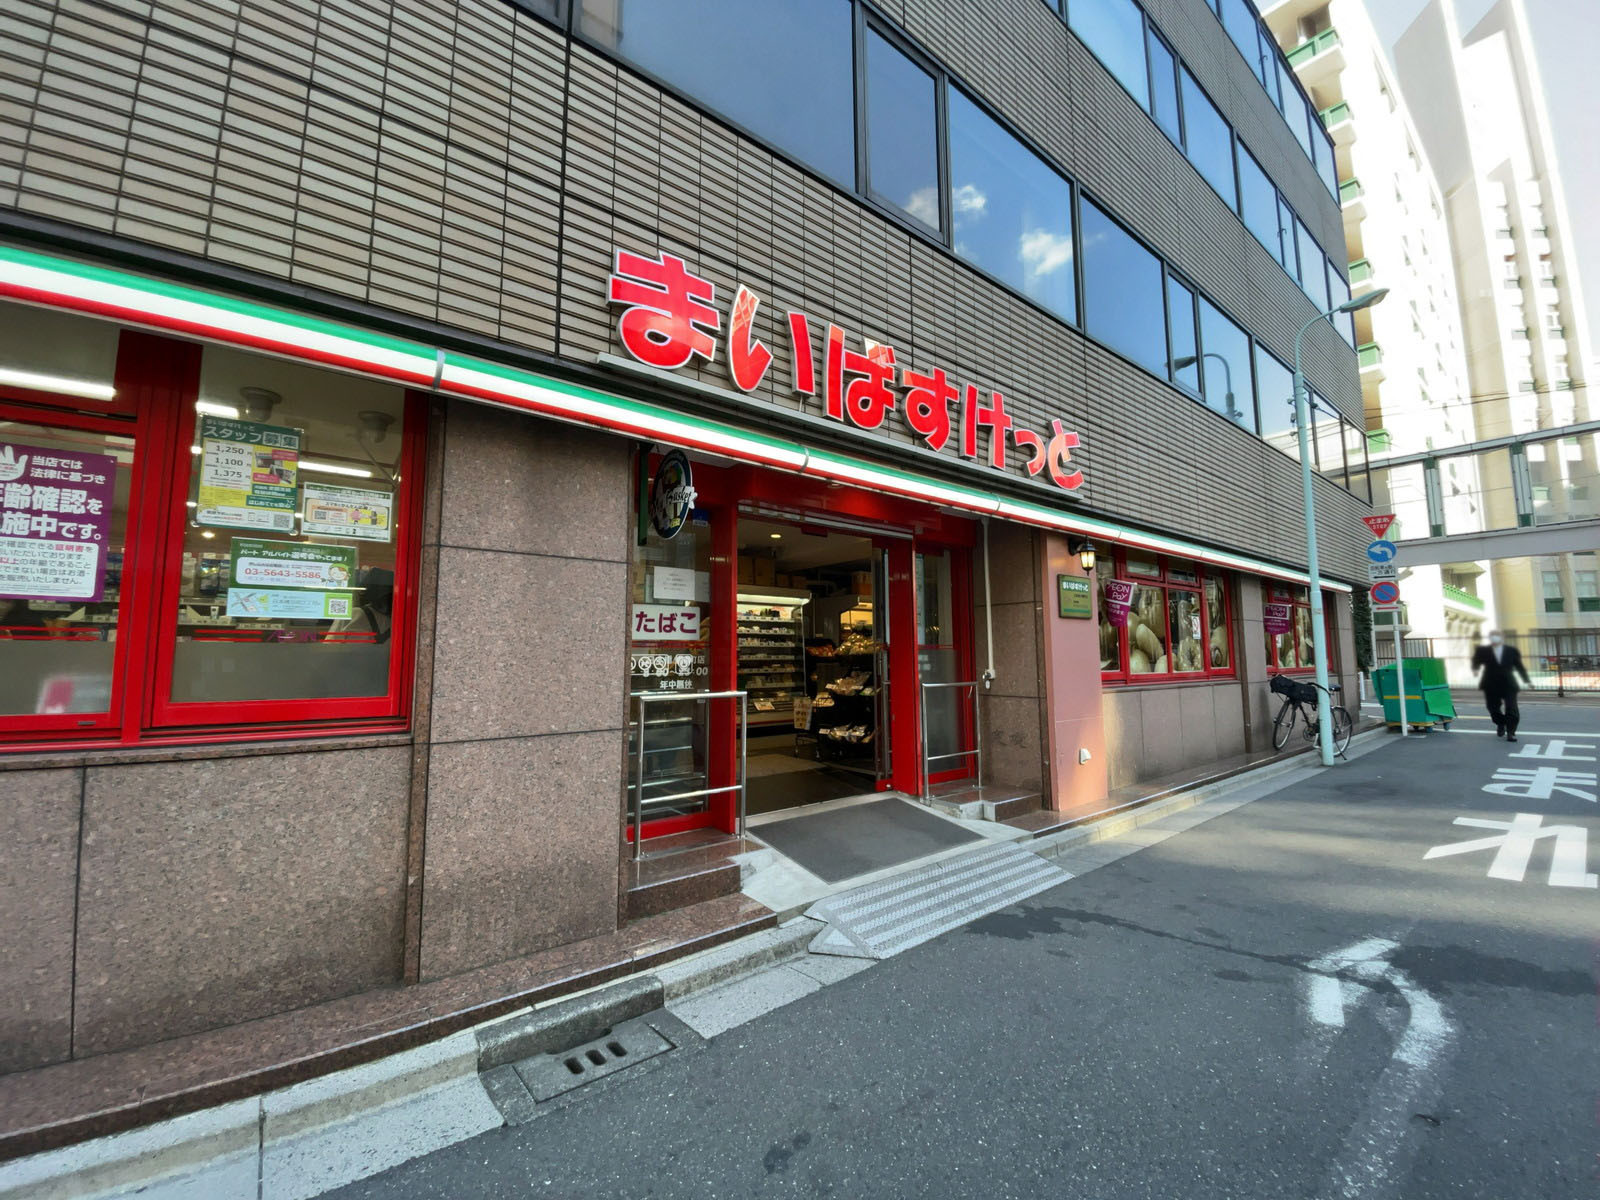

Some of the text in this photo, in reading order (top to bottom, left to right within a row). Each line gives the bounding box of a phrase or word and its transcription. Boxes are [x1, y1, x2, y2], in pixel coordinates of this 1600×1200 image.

[607, 248, 1085, 490] まいばすけっと
[216, 445, 244, 455] 1,250
[32, 455, 83, 469] 当店では
[215, 457, 244, 467] 1,100
[31, 468, 105, 484] 法律に基づき
[214, 469, 243, 479] 1,375
[0, 483, 103, 515] 齢確認を
[0, 511, 101, 540] 施中です。
[244, 568, 321, 579] 03-5643-5586
[635, 611, 697, 634] たばこ
[1423, 740, 1598, 888] 止まれ
